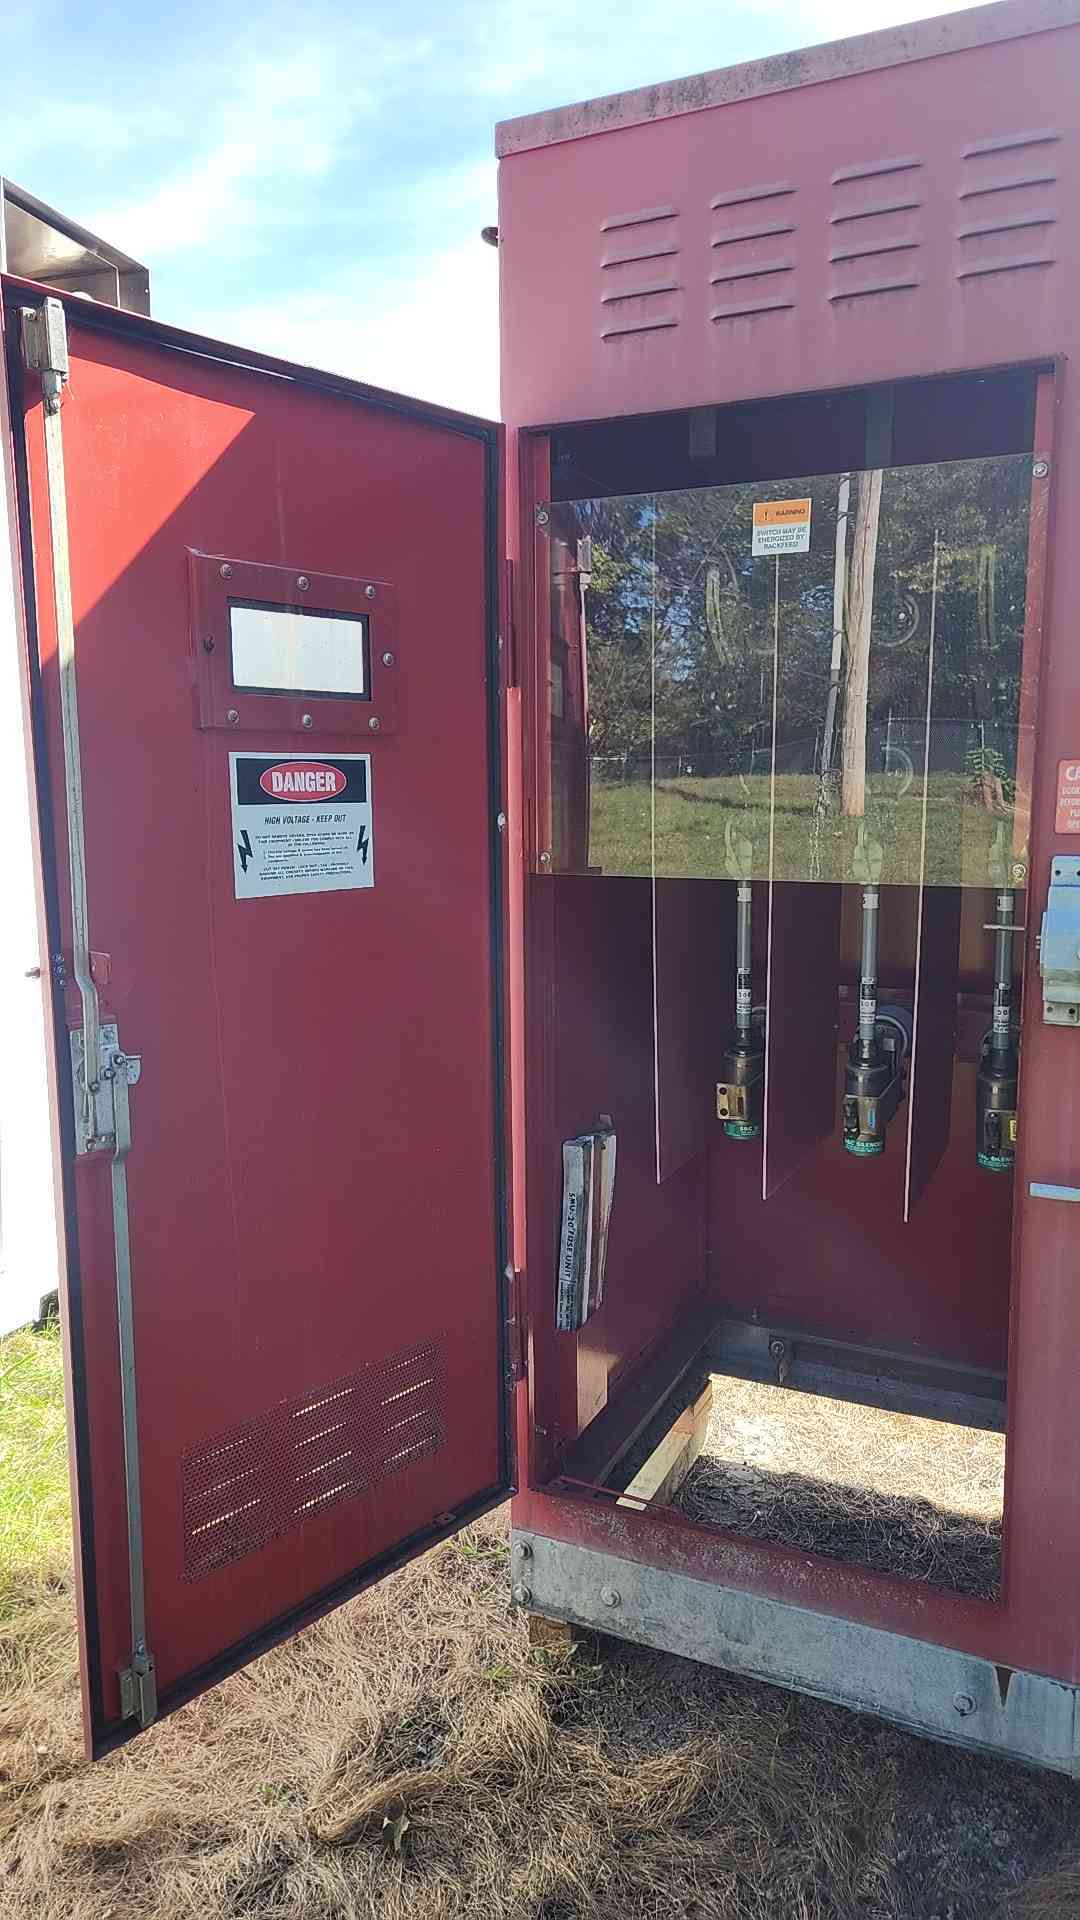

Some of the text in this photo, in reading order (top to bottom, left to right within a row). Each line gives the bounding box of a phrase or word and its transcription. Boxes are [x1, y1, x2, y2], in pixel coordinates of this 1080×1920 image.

[756, 528, 781, 536] SWITCH
[757, 535, 795, 543] ENERGIZED
[763, 541, 800, 549] BACKFEED
[271, 771, 337, 792] DANGER
[264, 816, 281, 825] HIGH
[282, 815, 310, 824] VOLTAGE
[315, 814, 332, 823] KEEP
[333, 813, 347, 823] OUT
[566, 1230, 575, 1252] FUSE
[563, 1255, 572, 1278] UNIT
